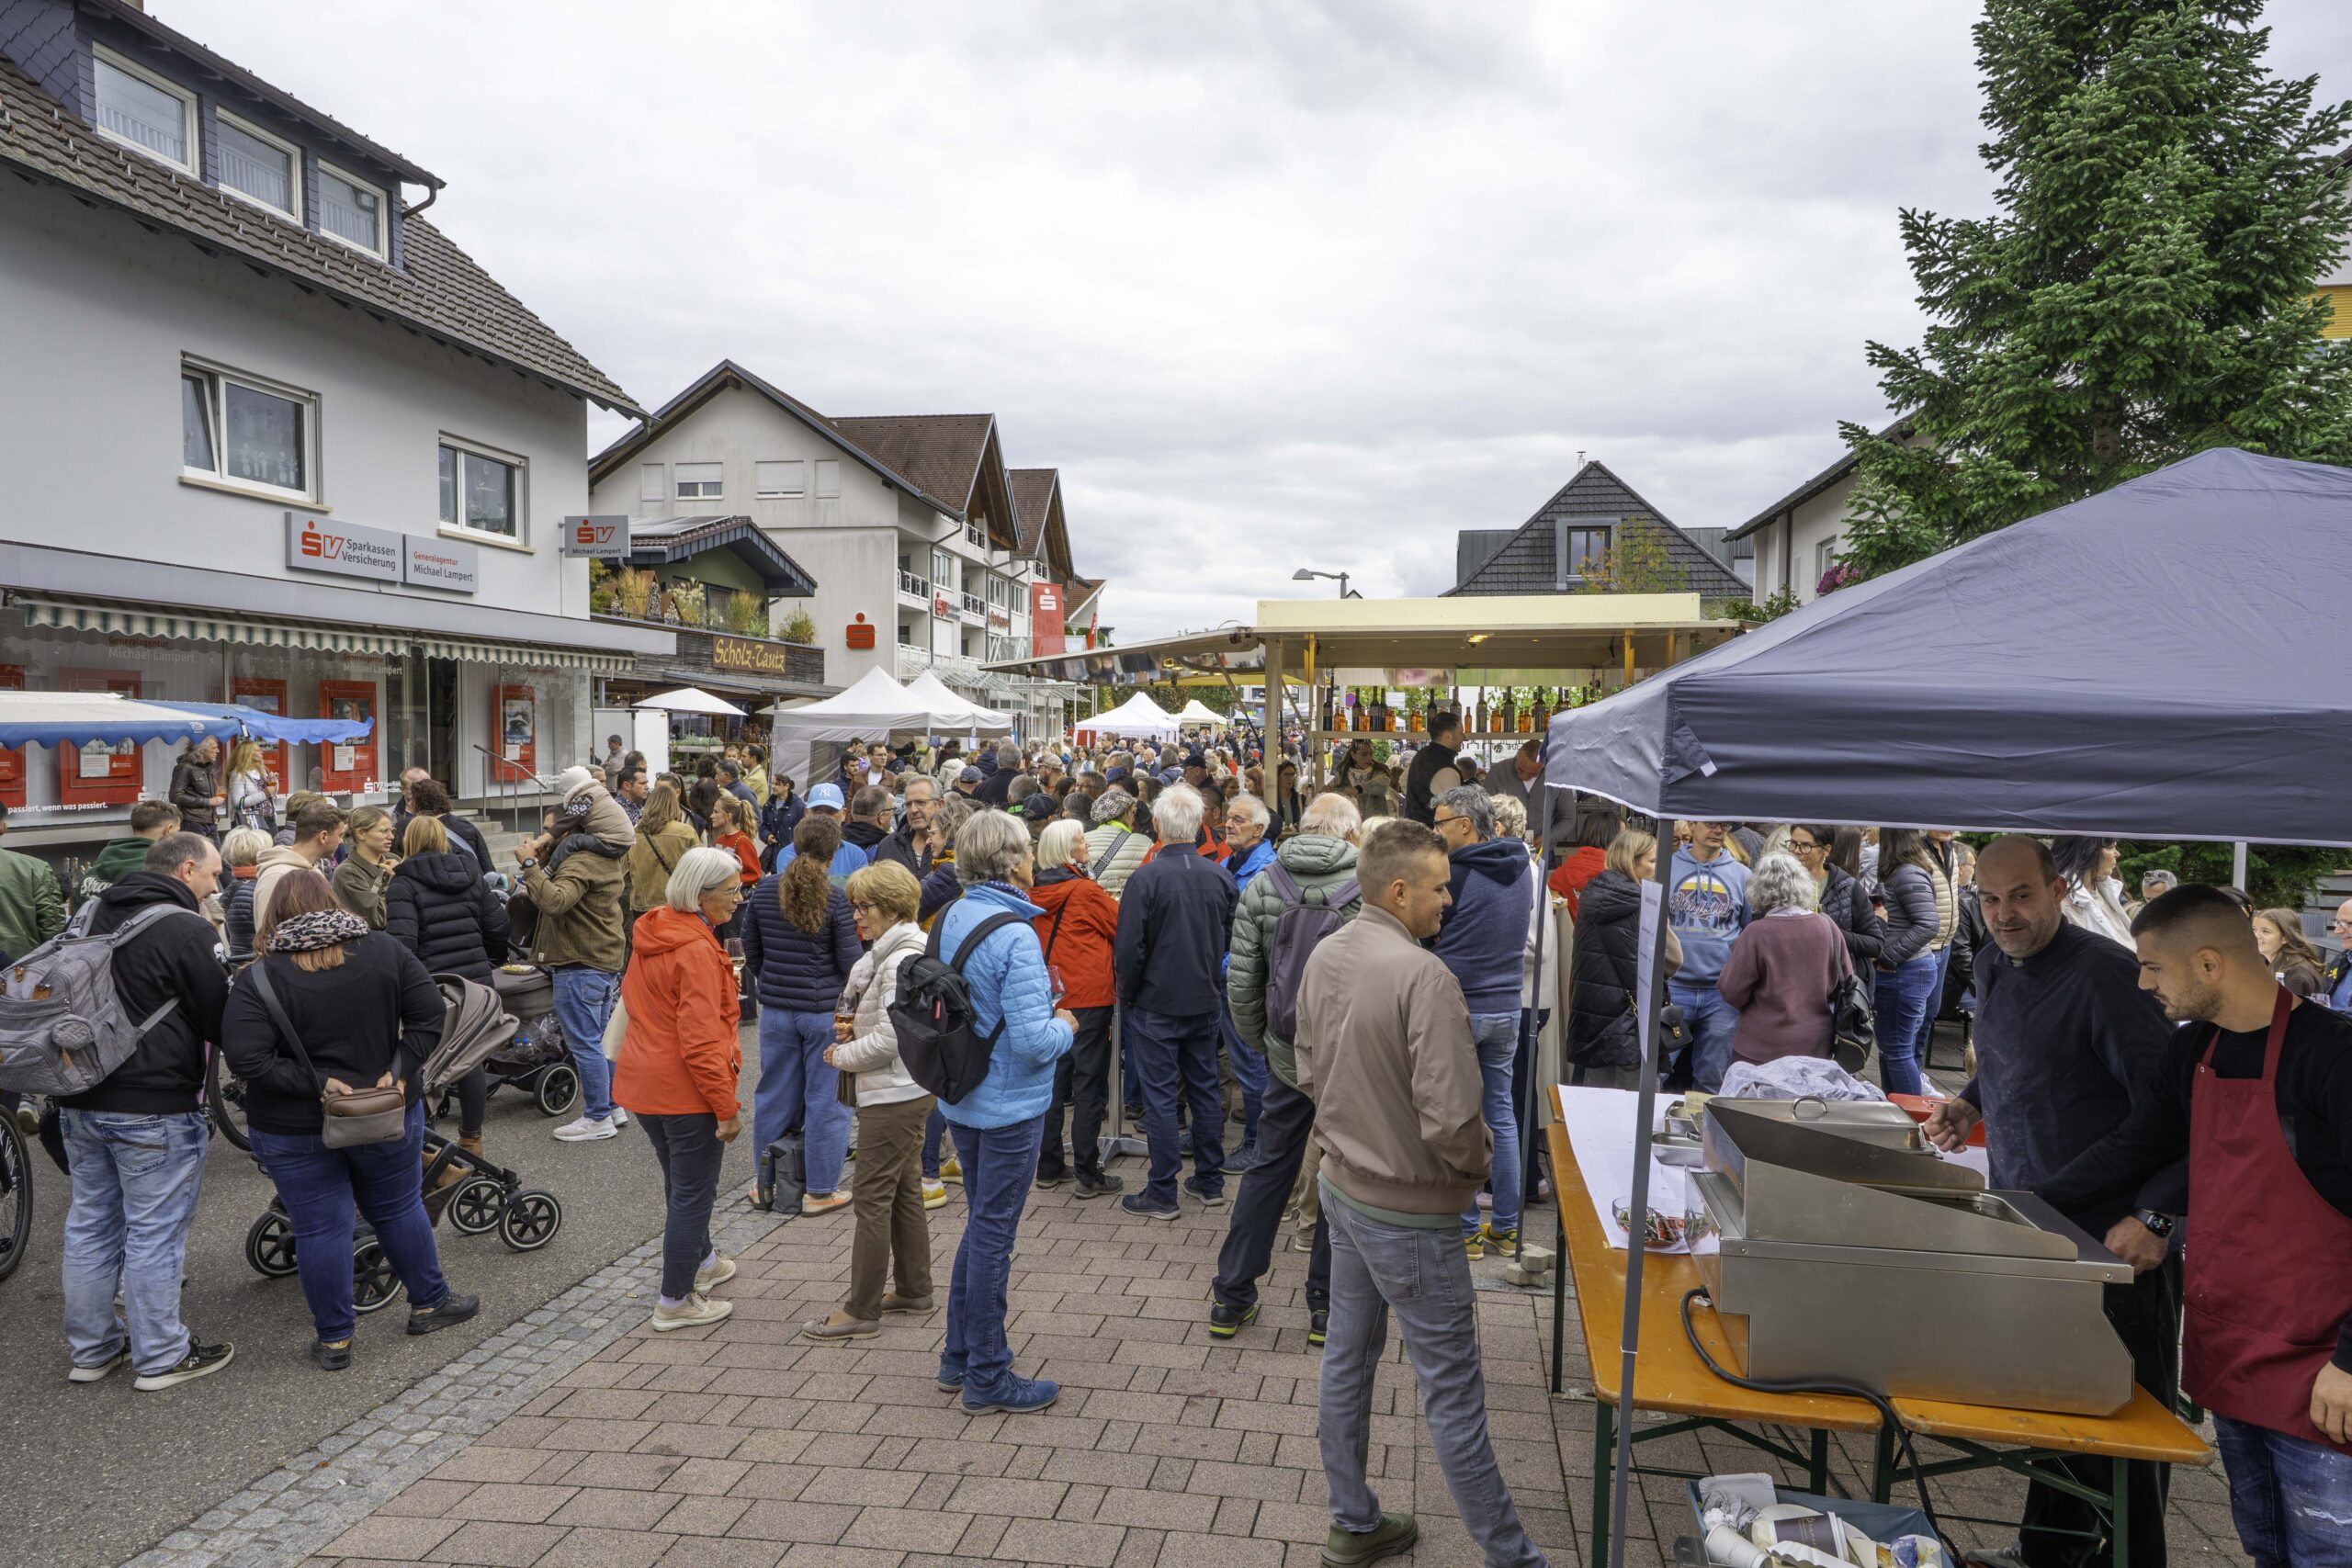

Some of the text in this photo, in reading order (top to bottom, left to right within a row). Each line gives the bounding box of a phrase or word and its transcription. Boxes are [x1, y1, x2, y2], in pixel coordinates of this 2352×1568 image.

[346, 538, 396, 557] Sparkassen
[342, 551, 396, 571] Versicherung
[413, 551, 458, 566] Generalagentur
[413, 563, 474, 582] Michael Lampert
[108, 636, 169, 648] Generalagentur
[108, 648, 195, 664] Michael Lampert
[344, 662, 402, 676] Michael Lampert
[7, 805, 41, 815] passiert,
[42, 804, 62, 812] wenn
[77, 802, 108, 812] passiert.
